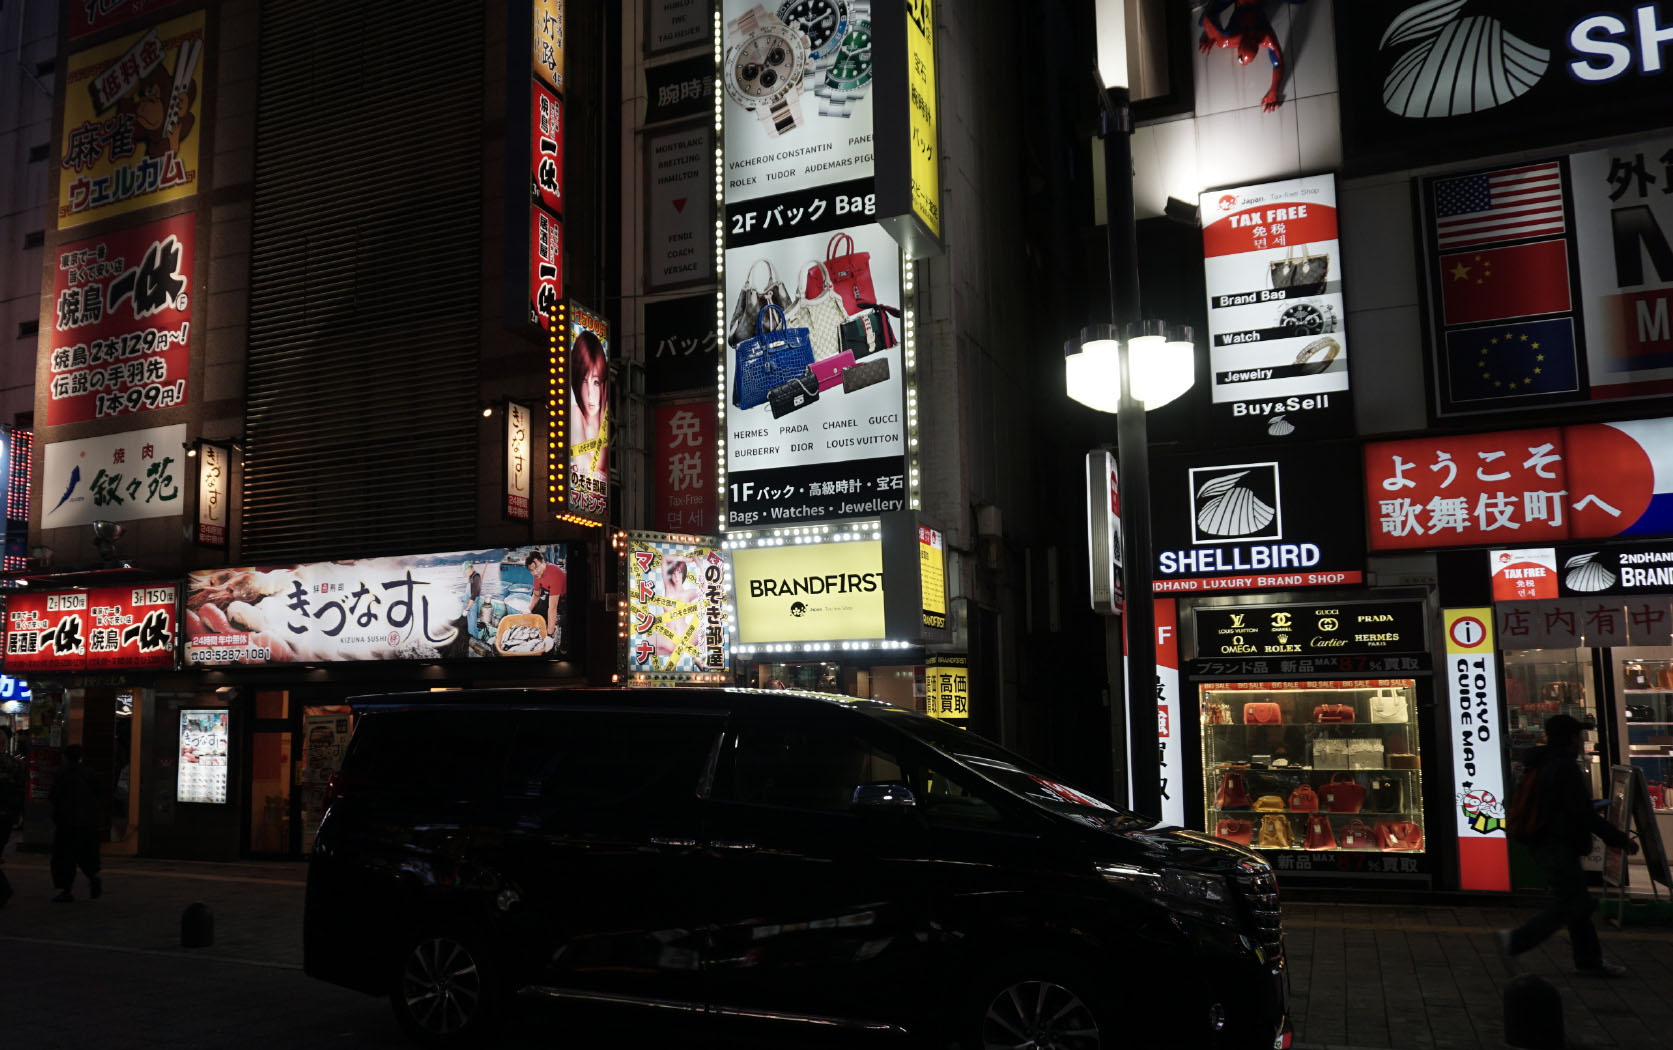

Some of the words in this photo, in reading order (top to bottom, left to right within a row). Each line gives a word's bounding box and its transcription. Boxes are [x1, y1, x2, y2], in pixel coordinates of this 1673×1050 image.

[100, 39, 160, 101] 低料金
[64, 114, 135, 171] 麻雀
[729, 154, 774, 170] VACHERON
[776, 143, 833, 161] CONSTANTIN
[729, 176, 757, 188] ROLEX
[766, 168, 796, 181] TUDOR
[804, 158, 852, 174] AUDEMARS
[732, 212, 757, 236] 2F
[762, 198, 828, 230] バック
[1229, 209, 1263, 229] TAX
[1267, 204, 1308, 223] FREE
[1252, 222, 1286, 238] 免税
[58, 283, 103, 331] 焼鳥
[107, 235, 186, 320] 一休
[1220, 292, 1257, 307] Brand
[1260, 289, 1286, 303] Bag
[1222, 331, 1261, 344] Watch
[51, 357, 167, 400] 伝説の手羽先
[1224, 367, 1273, 383] Jewelry
[733, 428, 769, 439] HERMES
[780, 424, 808, 435] PRADA
[822, 419, 858, 430] CHANEL
[868, 414, 898, 425] GUCCI
[113, 443, 154, 465] 焼肉
[668, 410, 704, 491] 免税
[734, 446, 781, 458] BURBERRY
[790, 442, 814, 452] DIOR
[827, 438, 855, 449] LOUIS
[856, 434, 899, 445] VUITTON
[1382, 442, 1562, 492] ようこそ
[89, 457, 178, 507] 叙々苑
[730, 482, 755, 503] 1F
[729, 511, 759, 525] Bags
[771, 505, 825, 519] Watches
[838, 499, 903, 516] Jewellery
[1378, 490, 1622, 538] 歌舞伎町へ
[1159, 543, 1320, 574] SHELLBIRD
[1203, 578, 1252, 589] LUXURY
[1258, 576, 1302, 587] BRAND
[1308, 573, 1345, 584] SHOP
[1504, 569, 1523, 579] TAX
[1524, 567, 1547, 578] FREE
[1620, 566, 1673, 588] BRAN
[287, 569, 458, 644] きづなすし
[635, 551, 654, 664] マドンナ
[8, 631, 39, 655] 居酒屋
[90, 629, 119, 652] 焼鳥
[192, 635, 217, 646] 24時間
[340, 636, 365, 644] KIZUNA
[1221, 644, 1258, 654] OMEGA
[1264, 644, 1302, 653] ROLEX
[1310, 636, 1349, 647] Cartier
[1197, 661, 1268, 674] ブランド品
[940, 673, 967, 693] 高価
[1457, 658, 1472, 725] GUIDE
[941, 694, 967, 714] 買取
[1473, 656, 1491, 743] TOKYO
[1462, 740, 1476, 777] MAP
